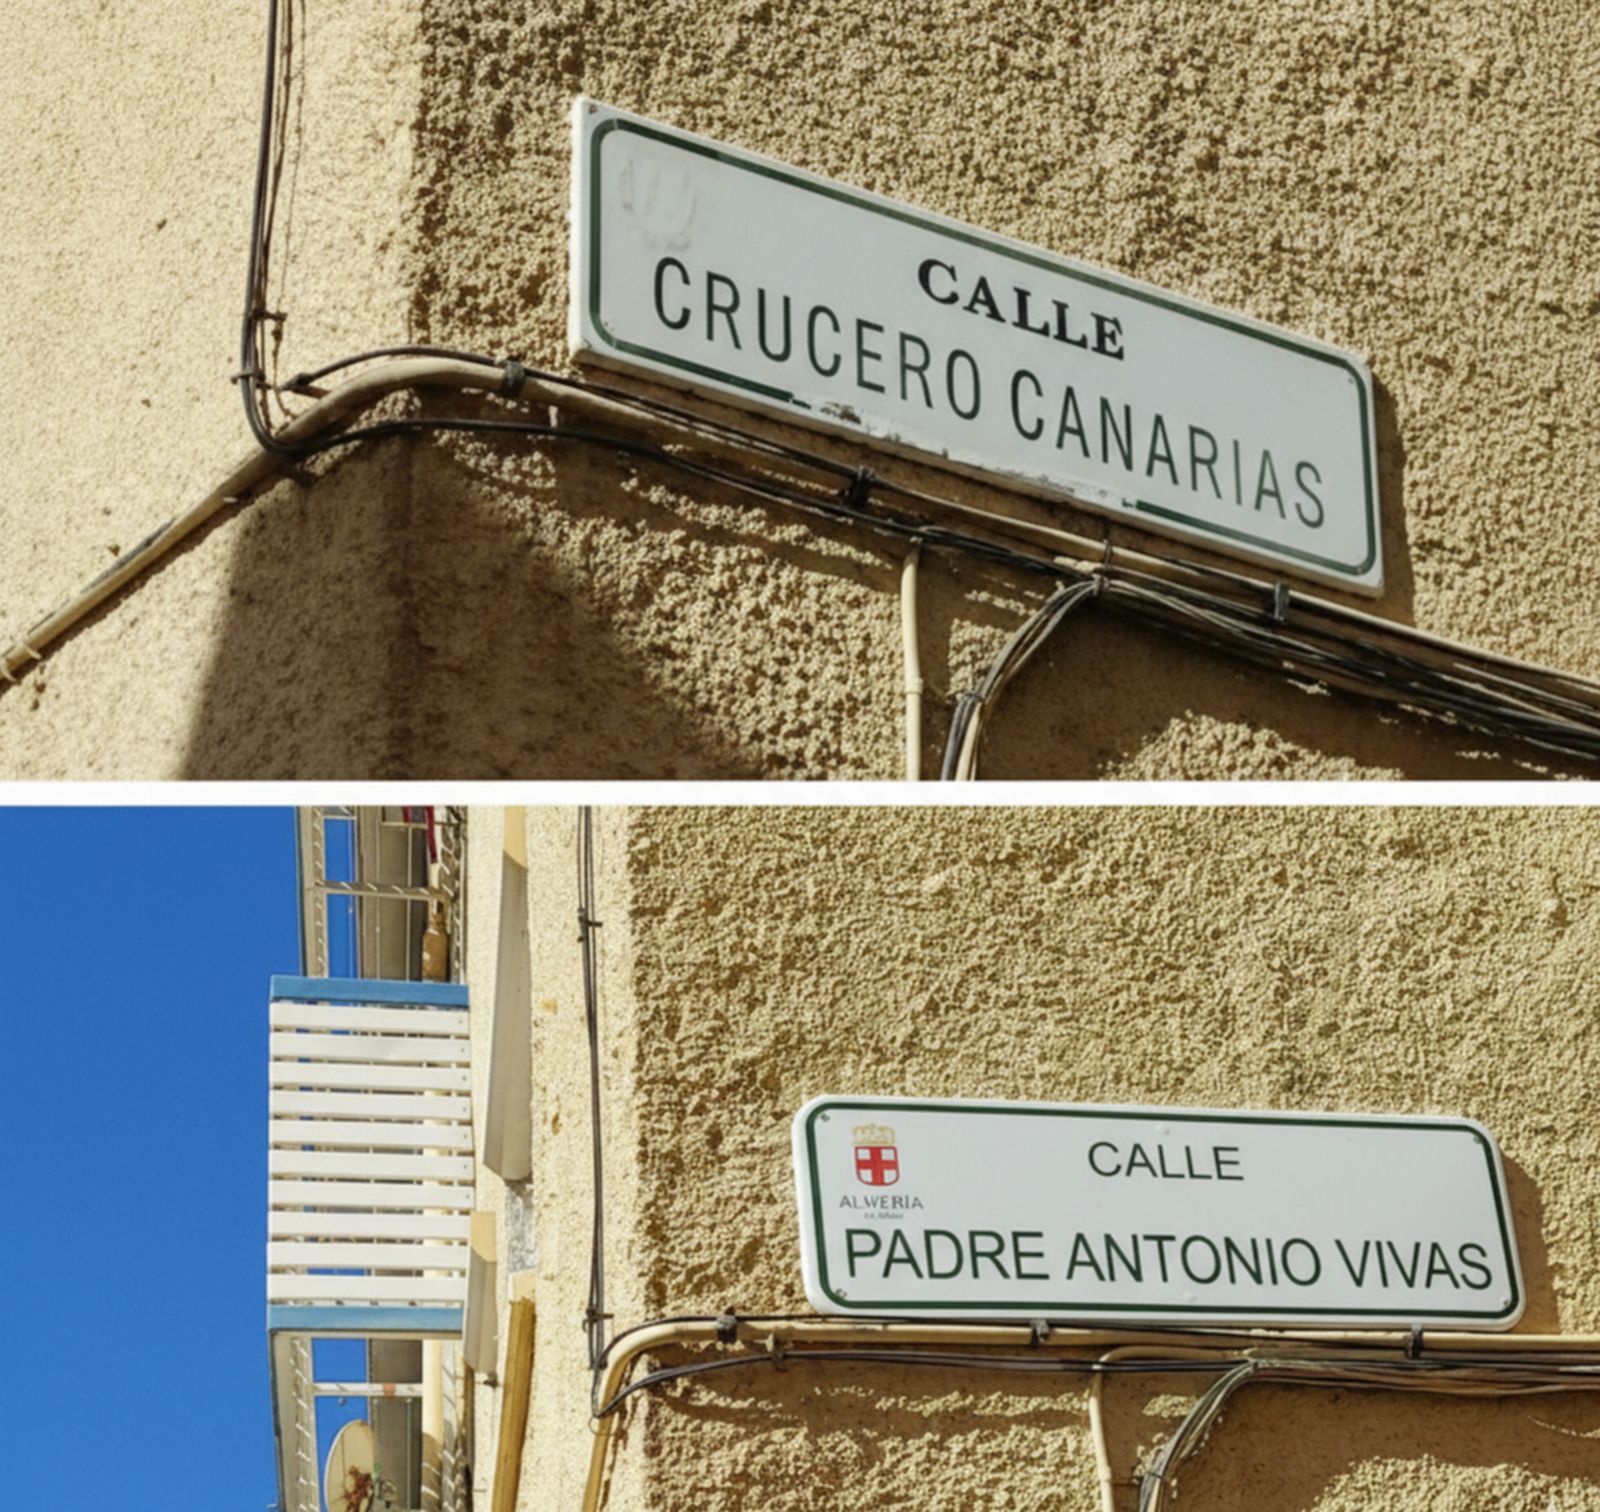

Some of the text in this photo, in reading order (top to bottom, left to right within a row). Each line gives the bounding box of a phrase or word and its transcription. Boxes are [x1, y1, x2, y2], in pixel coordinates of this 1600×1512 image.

[917, 258, 1125, 361] CALLE
[654, 256, 1325, 529] CRUCERO CANARIAS
[1088, 1141, 1244, 1181] CALLE
[846, 1228, 1493, 1291] PADRE ANTONIO VIVAS
